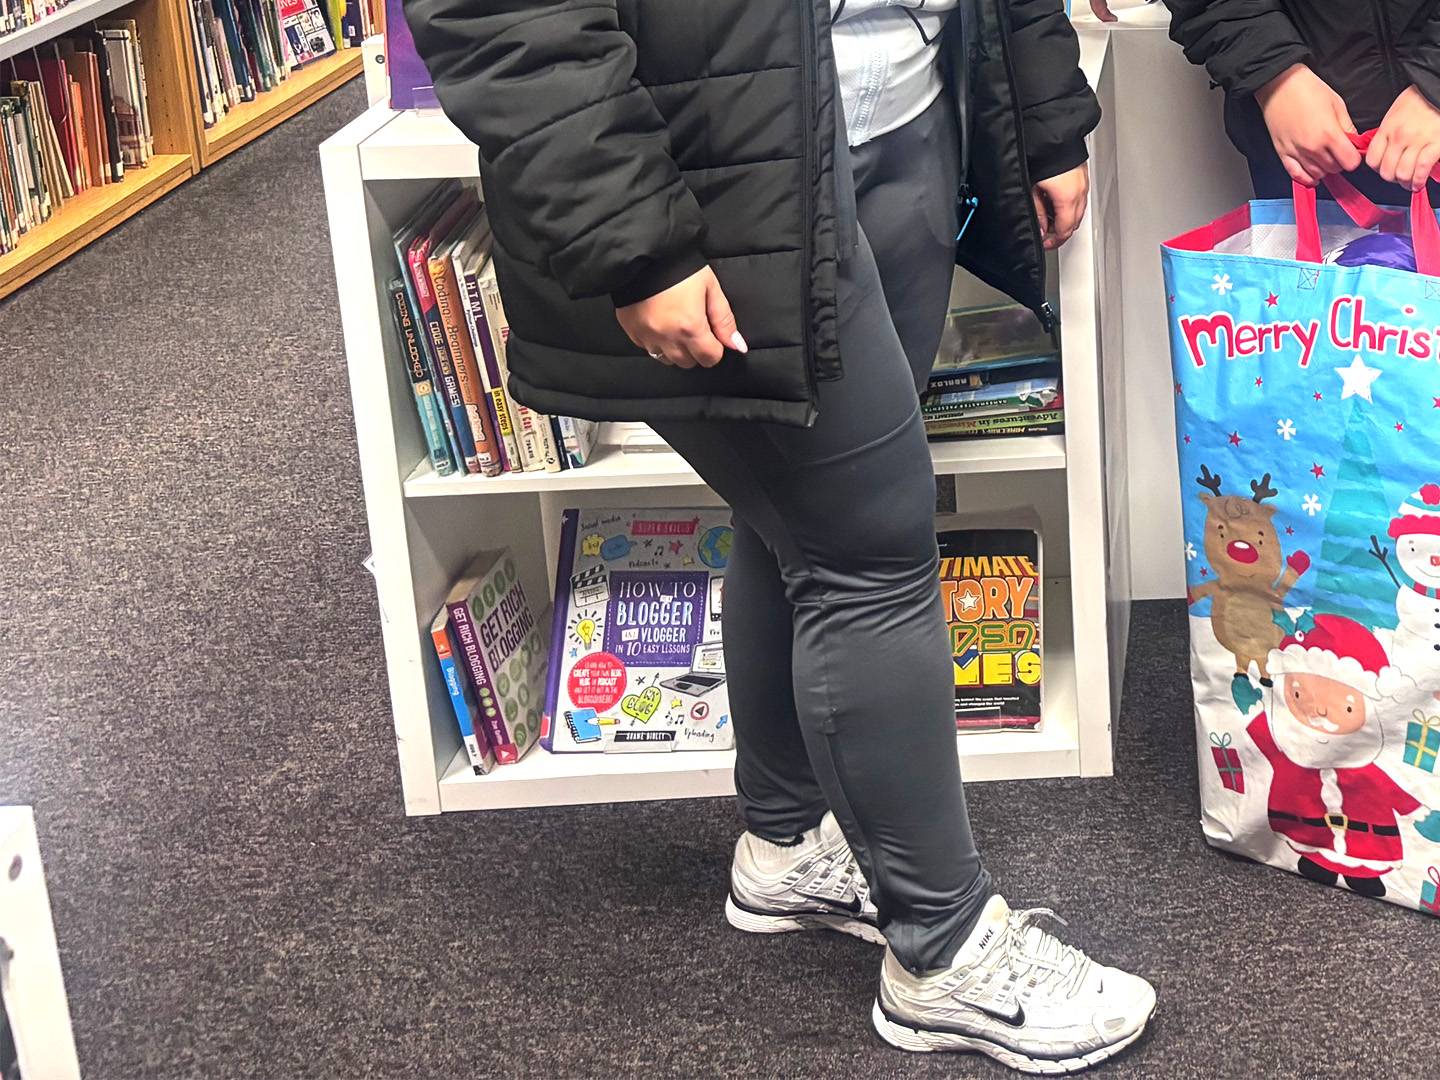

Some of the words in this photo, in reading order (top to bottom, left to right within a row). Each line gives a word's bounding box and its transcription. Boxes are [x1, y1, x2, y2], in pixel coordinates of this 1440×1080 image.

[465, 280, 484, 322] HTML
[395, 292, 411, 328] CODING
[405, 328, 424, 379] UNLOCKED
[429, 321, 444, 345] CODE
[433, 275, 451, 317] Coding
[447, 324, 468, 384] Beginners
[1181, 313, 1318, 367] Merry
[930, 377, 968, 389] ROBLOX
[495, 397, 505, 415] easy
[499, 415, 509, 432] steps
[978, 419, 991, 427] in
[992, 412, 1058, 426] Adventures
[938, 555, 1039, 578] TIMATE
[619, 581, 665, 598] HOW
[669, 581, 696, 598] TO
[940, 576, 1035, 623] TORY
[452, 607, 463, 624] GET
[480, 607, 500, 647] GET
[502, 581, 527, 632] RICH
[616, 601, 694, 626] BLOGGER
[458, 624, 473, 646] RICH
[488, 606, 534, 674] BLOGGING
[641, 627, 686, 643] VLOGGER
[615, 644, 624, 654] IN
[626, 641, 642, 657] 10
[643, 644, 660, 654] EASY
[661, 644, 691, 654] LESSONS
[464, 643, 487, 686] BLOGGING
[573, 670, 590, 678] CREATE
[446, 667, 460, 696] Blogging
[597, 677, 618, 686] PODCAST
[684, 727, 715, 743] Uploading
[978, 925, 996, 950] NIKE
